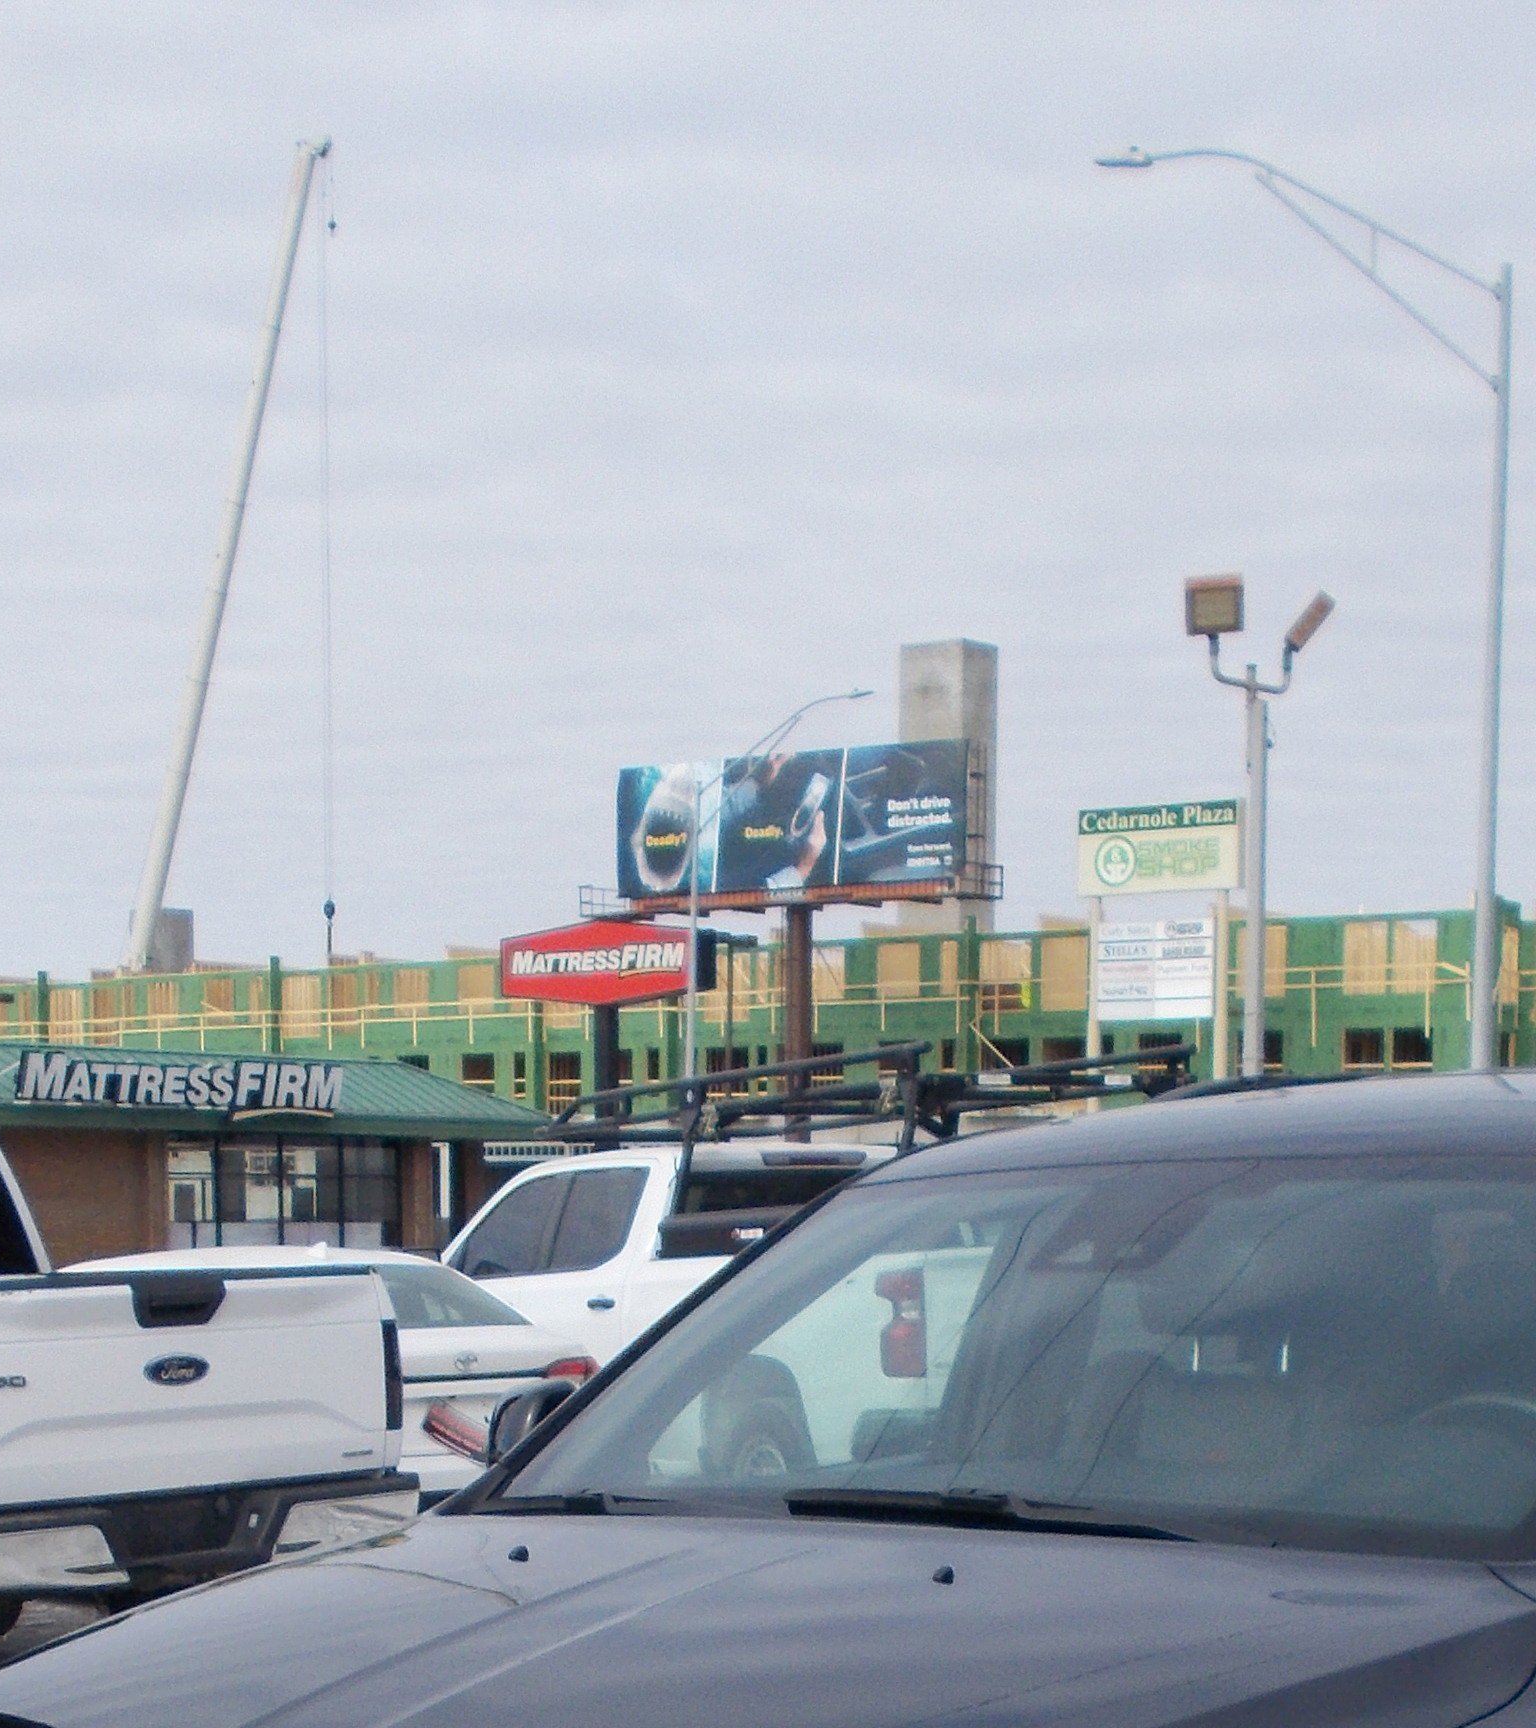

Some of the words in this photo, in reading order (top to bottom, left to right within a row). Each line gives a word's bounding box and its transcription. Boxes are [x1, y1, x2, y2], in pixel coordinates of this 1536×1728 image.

[920, 795, 951, 809] drive
[1081, 808, 1178, 832] Cedarnole
[1183, 805, 1234, 825] Plaza
[1137, 836, 1220, 854] SMOKE
[1136, 856, 1221, 878] SHOP
[160, 1364, 196, 1381] Ford
